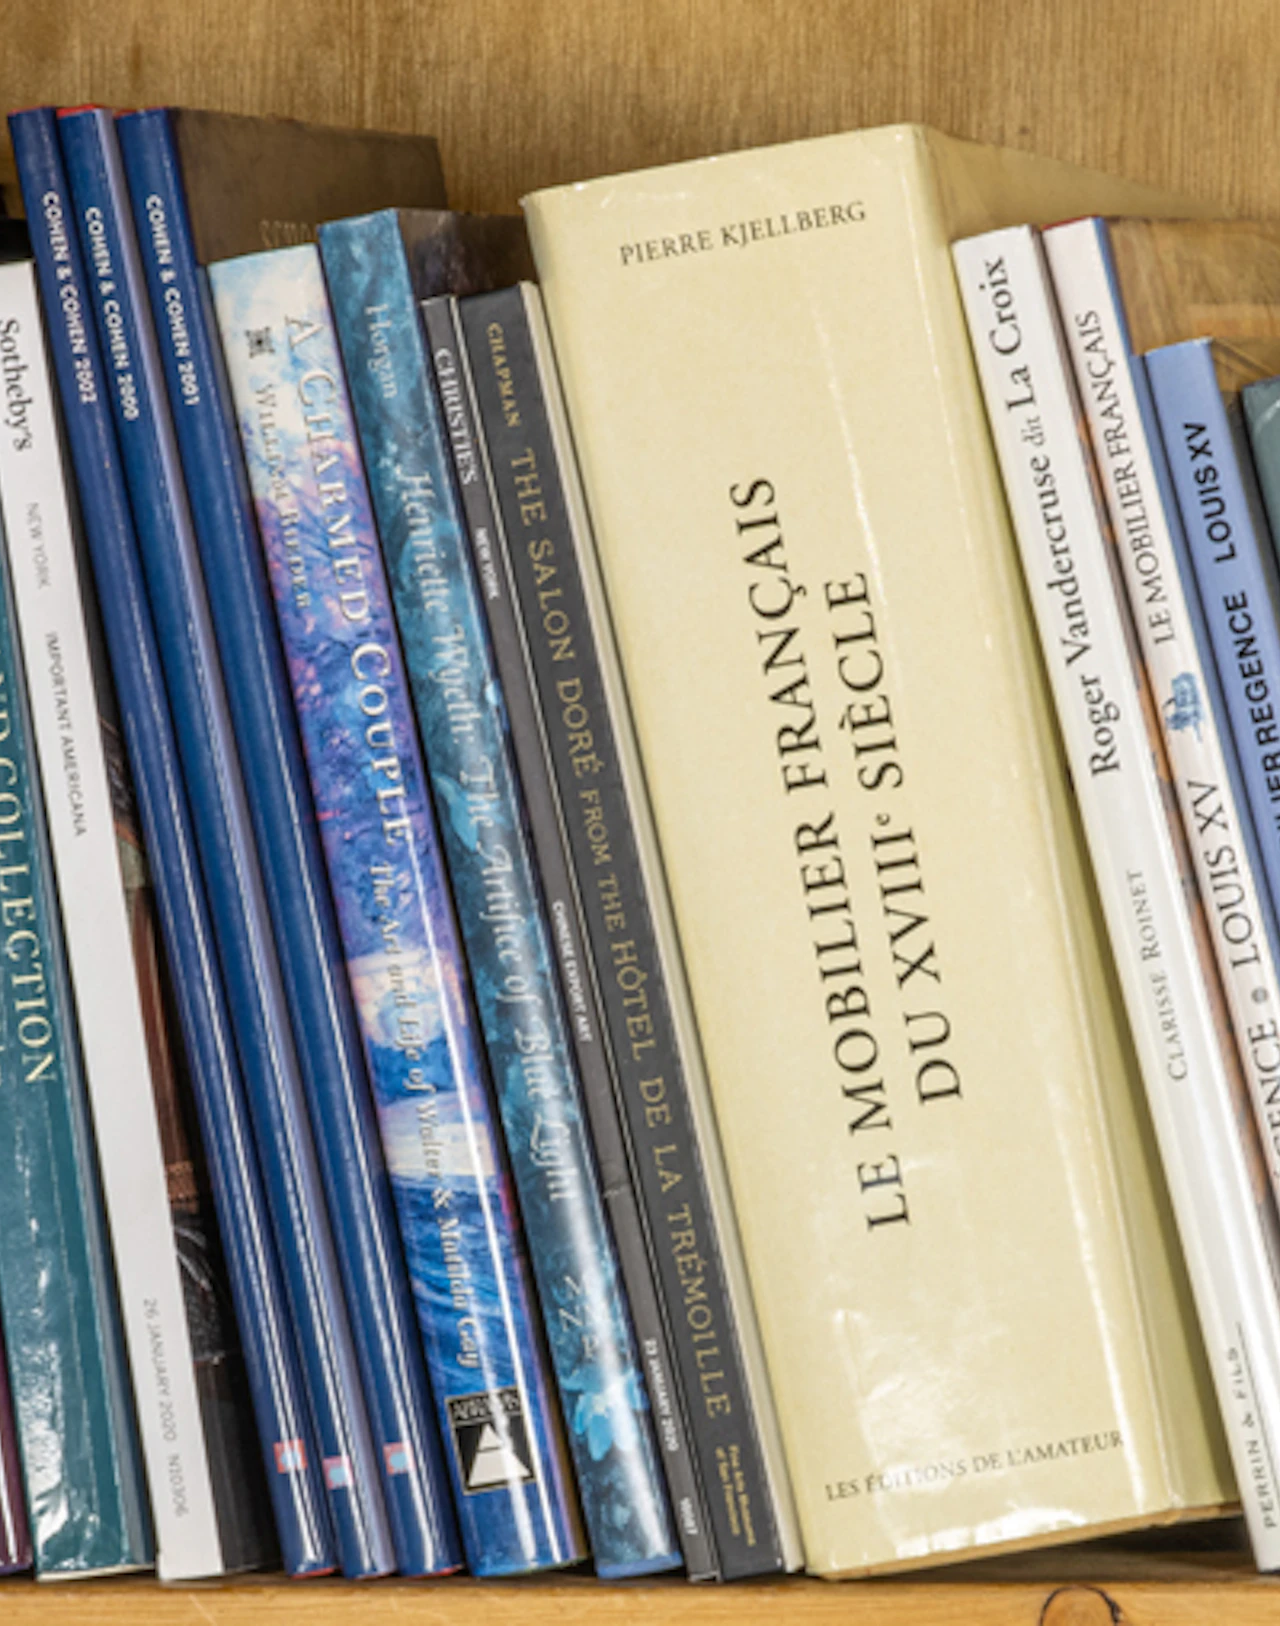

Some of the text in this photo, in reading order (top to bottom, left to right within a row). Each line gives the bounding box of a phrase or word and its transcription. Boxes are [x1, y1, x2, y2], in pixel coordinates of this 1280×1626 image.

[43, 191, 88, 354] COHEN COHEN
[85, 206, 112, 278] COHEN
[104, 300, 130, 369] COHEN
[146, 194, 173, 265] COHEN
[165, 287, 190, 357] COHEN
[619, 201, 867, 266] PIERRE KJELLBERG
[979, 255, 1121, 778] Roger Vandercruse dit La Croix
[1075, 310, 1169, 607] MOBILIER FRANÇAIS
[1183, 422, 1214, 463] XV
[1194, 464, 1237, 564] LOUIS
[298, 370, 369, 621] CHARMED
[351, 643, 412, 846] COUPLE
[365, 304, 500, 828] Horgan Henriette The
[45, 631, 88, 838] IMPORTANT AMERICANA
[1187, 780, 1229, 837] XV
[486, 322, 731, 1419] CHAPMAN THE SALON DORÉ FROM THE HÔTEL LA TRÉMOILLE
[729, 478, 912, 1232] LE MOBILIER FRANÇAIS
[824, 571, 963, 1104] DU SIÈCLE
[1204, 844, 1261, 970] LOUIS
[1125, 869, 1188, 1082] CLARISSE ROINET
[147, 1324, 171, 1400] JANUARY
[1227, 1346, 1277, 1528] PERRIN FILS
[825, 1429, 1125, 1502] LES L'AMATEUR
